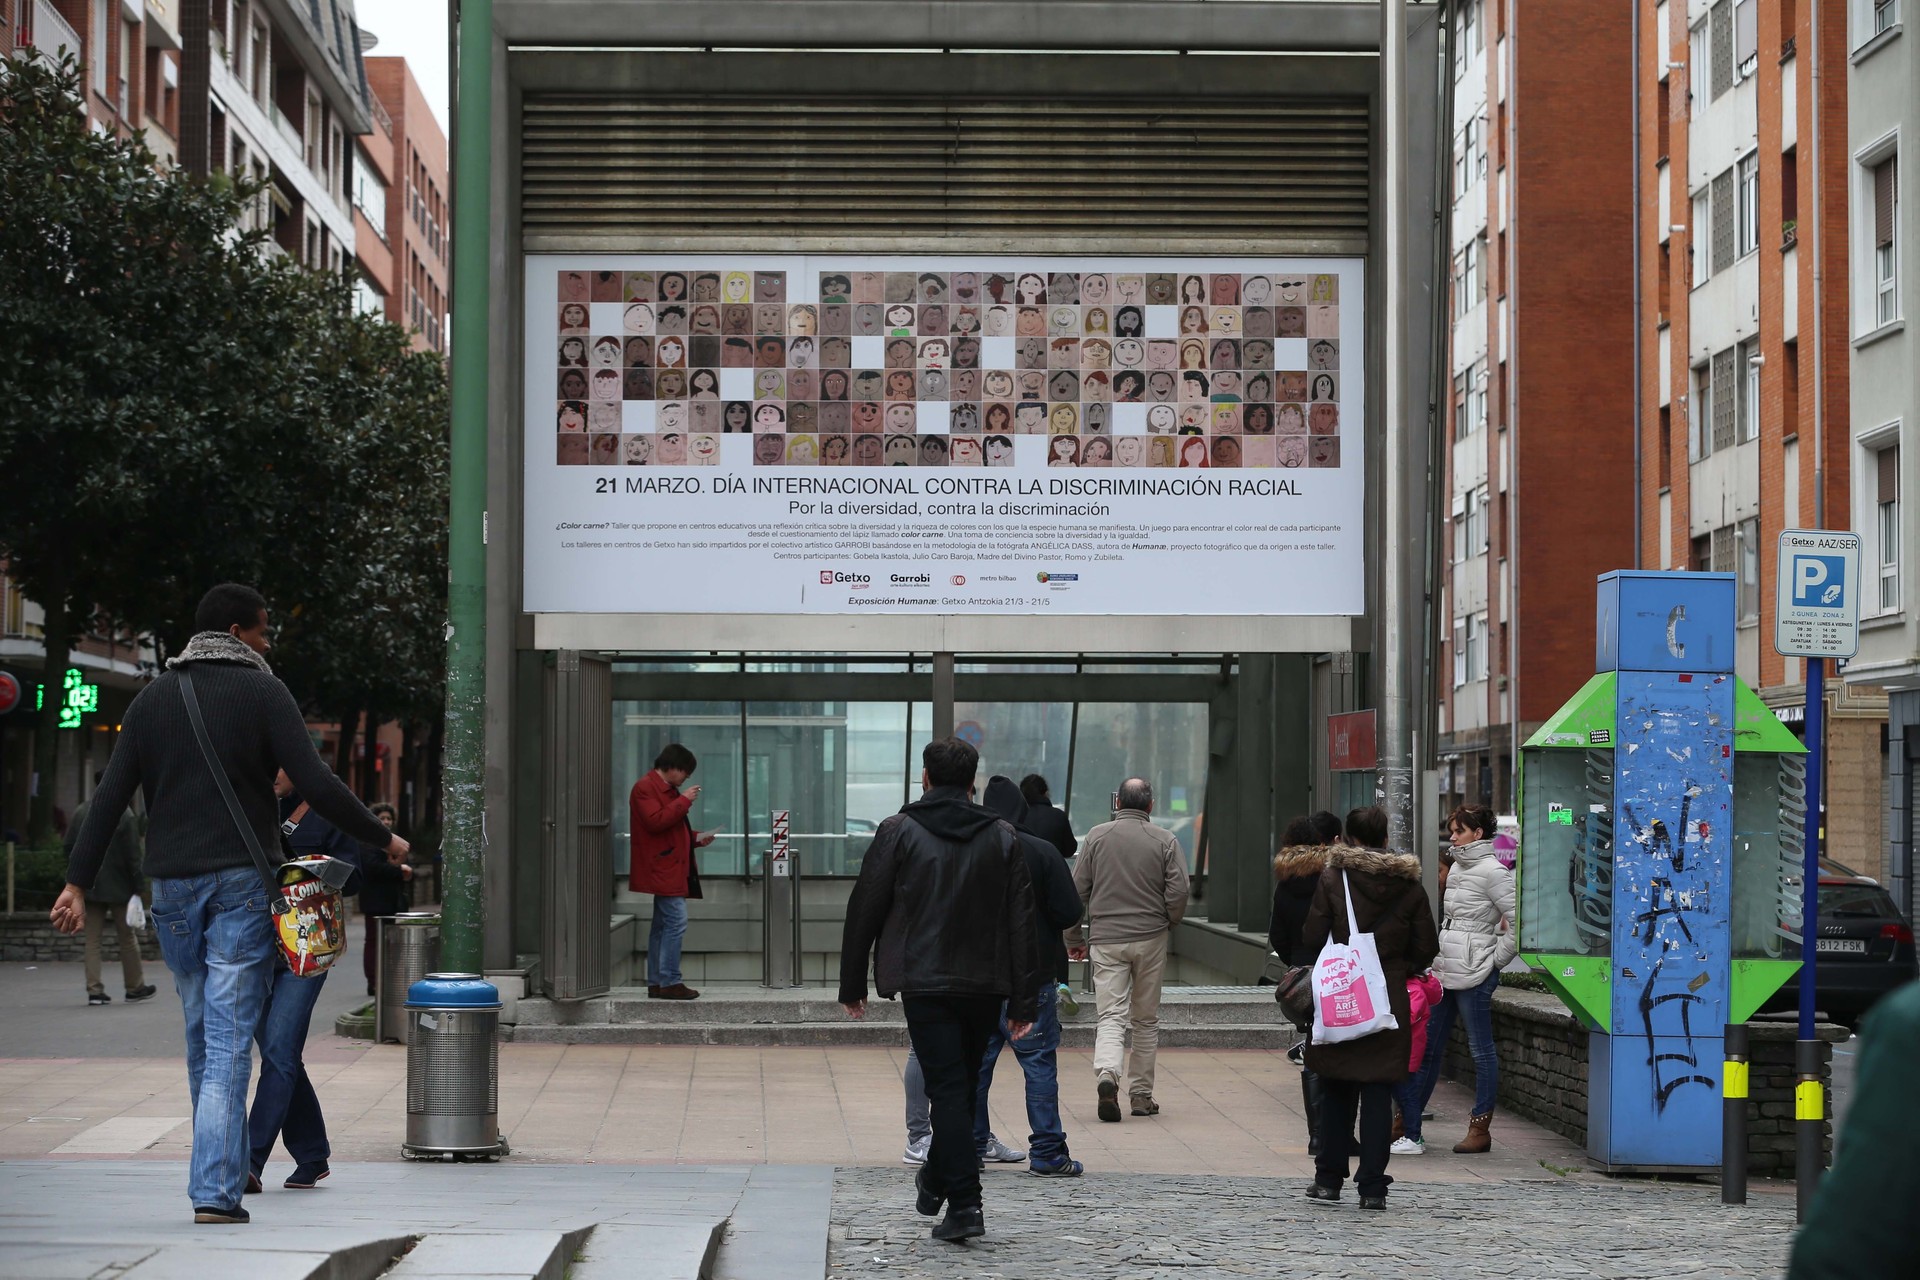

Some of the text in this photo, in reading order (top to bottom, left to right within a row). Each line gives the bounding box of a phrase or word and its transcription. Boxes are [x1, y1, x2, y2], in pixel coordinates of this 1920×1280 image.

[595, 472, 1303, 496] 21 MARZO. DÍA INTERNACIONAL CONTRA LA DISCRIMINACIÓN RACIAL
[788, 500, 1110, 517] Por la diversidad, contra la discriminación
[555, 521, 582, 530] ¿Color
[582, 521, 610, 529] carne?
[688, 522, 716, 530] centros
[850, 522, 857, 530] la
[858, 522, 896, 530] diversidad
[911, 523, 938, 531] riqueza
[1005, 524, 1019, 532] que
[1028, 524, 1057, 532] especie
[1058, 523, 1087, 531] humana
[1139, 523, 1150, 531] Un
[1150, 524, 1171, 532] juego
[1190, 524, 1225, 532] encontrar
[1253, 524, 1267, 532] real
[1298, 524, 1341, 533] participante
[779, 530, 838, 538] cuestionamiento
[870, 530, 900, 538] llamado
[1056, 531, 1064, 539] la
[1064, 531, 1102, 539] diversidad
[653, 540, 676, 548] Getxo
[708, 541, 747, 549] impartidos
[834, 541, 871, 549] GARROBI
[923, 541, 930, 549] la
[1120, 542, 1131, 550] de
[1170, 543, 1202, 551] proyecto
[1269, 543, 1292, 551] origen
[1791, 537, 1858, 550] Getxo AAZ/SER
[772, 551, 802, 559] Centros
[802, 552, 851, 560] participantes:
[880, 552, 911, 560] Ikastola,
[911, 552, 930, 560] Julio
[930, 552, 949, 560] Caro
[949, 552, 975, 561] Baroja,
[976, 552, 1000, 560] Madre
[1013, 552, 1037, 560] Divino
[1038, 553, 1063, 561] Pastor,
[1064, 553, 1086, 561] Romo
[1093, 553, 1125, 561] Zubileta.
[834, 571, 871, 583] Getxo
[890, 573, 931, 583] Garrobi
[1795, 558, 1828, 599] P
[847, 596, 896, 606] Exposición
[941, 596, 966, 605] Getxo
[967, 597, 1003, 605] Antzokia
[1004, 597, 1024, 606] 21/3
[1031, 597, 1052, 606] 21/5
[1842, 940, 1861, 951] FSK
[1335, 999, 1358, 1011] ARTE
